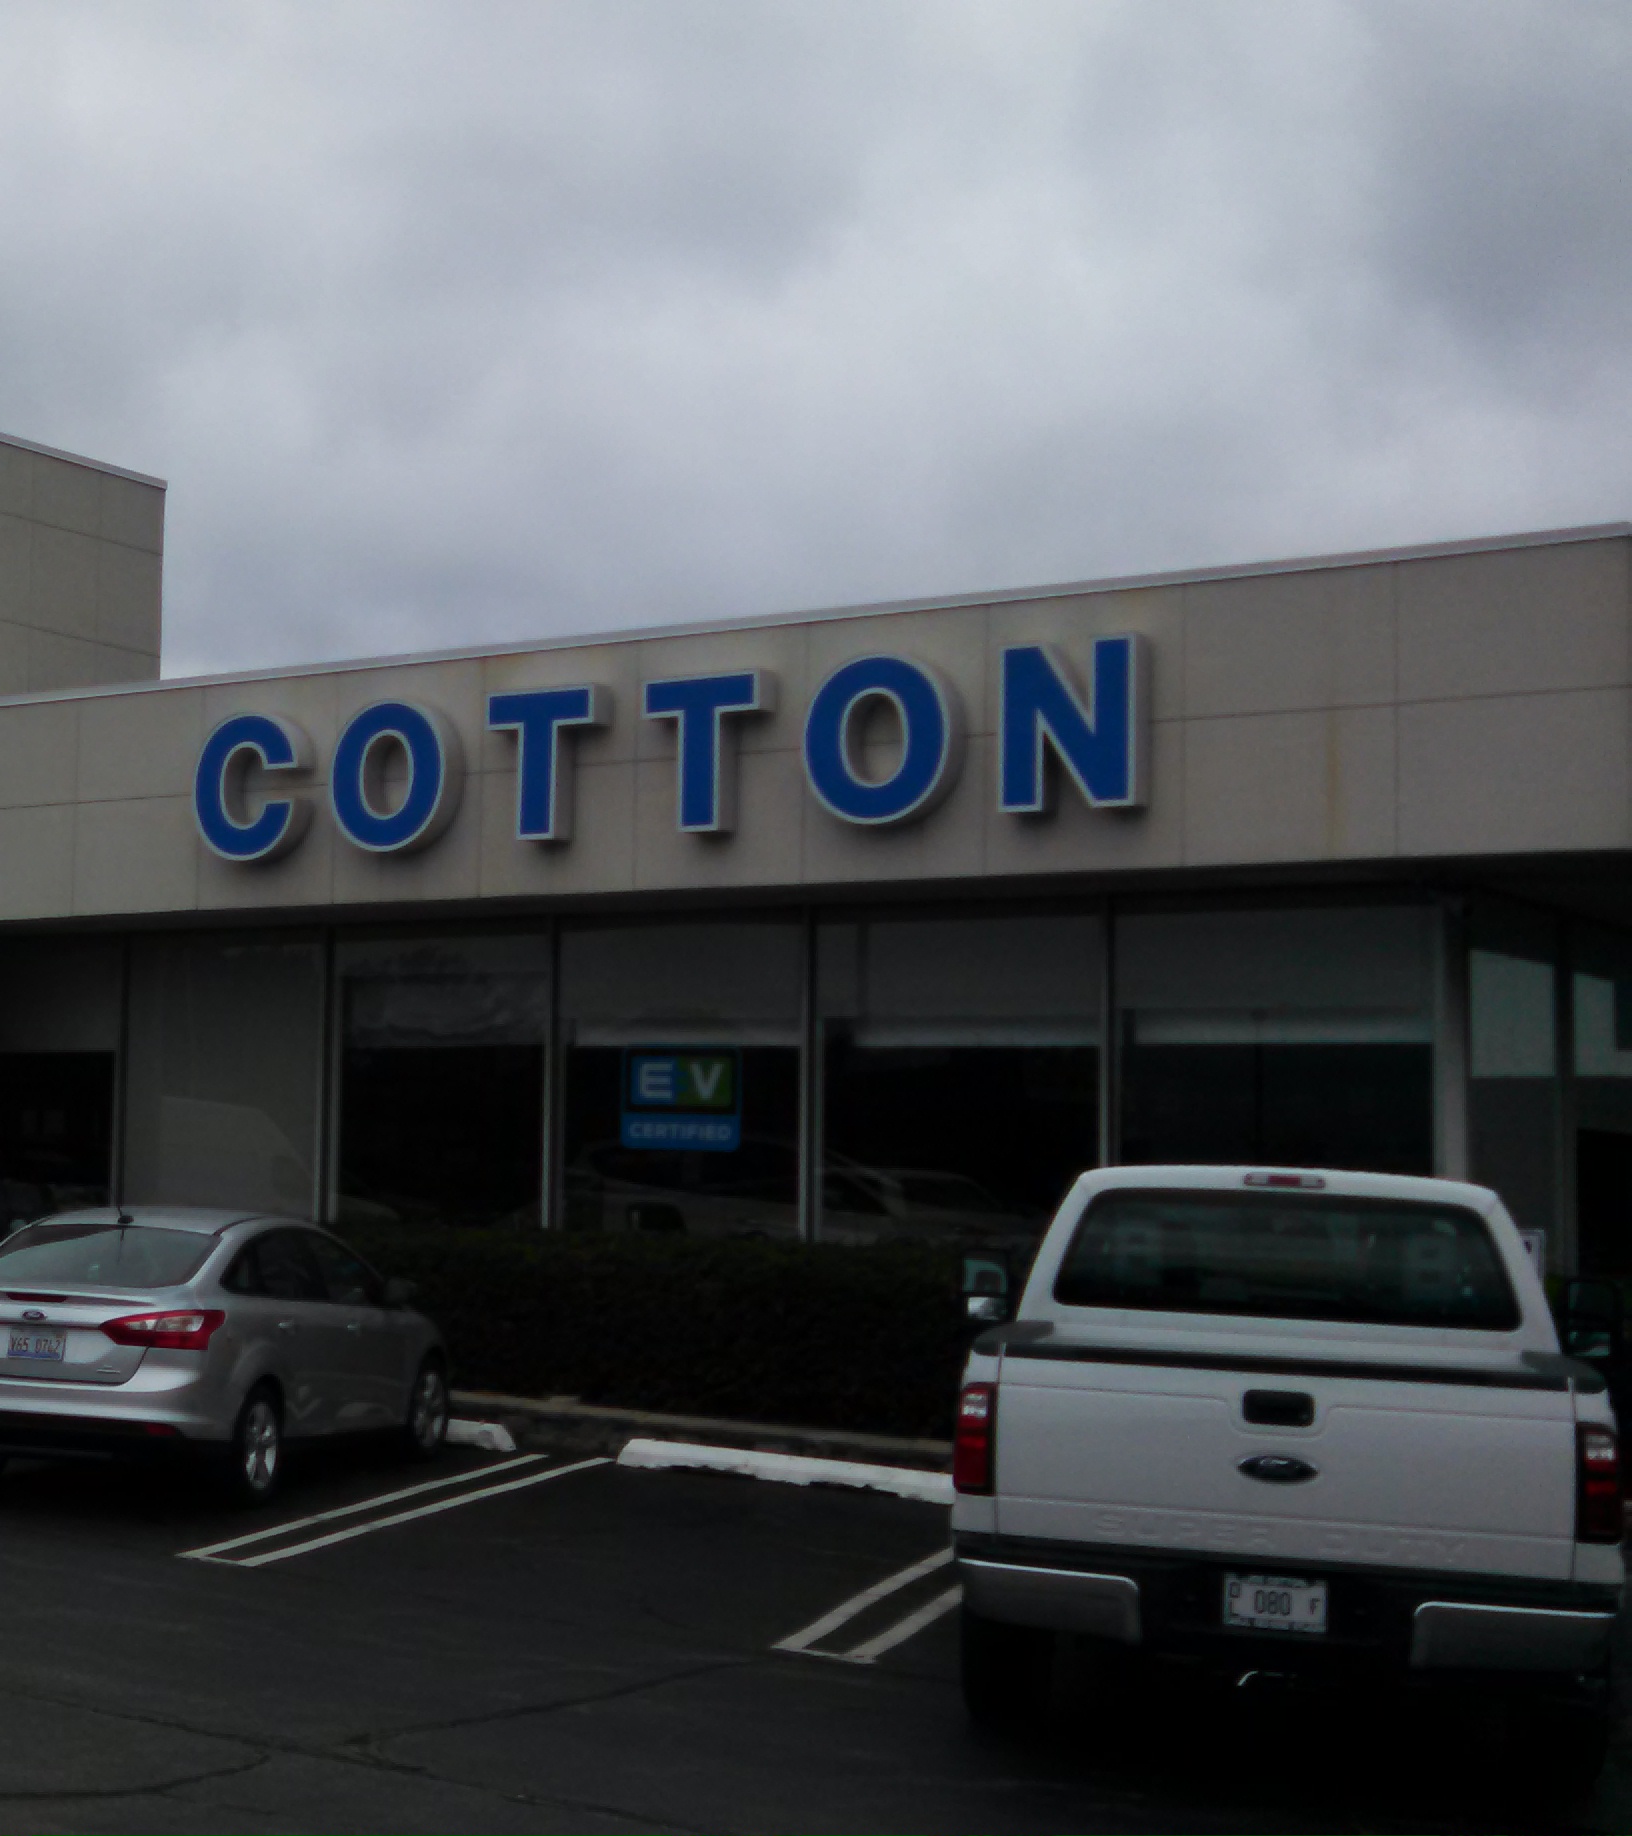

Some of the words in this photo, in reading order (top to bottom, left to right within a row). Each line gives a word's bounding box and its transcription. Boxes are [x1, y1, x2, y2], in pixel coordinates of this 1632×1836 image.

[195, 632, 1146, 862] COTTON
[636, 1060, 724, 1102] EV
[627, 1120, 732, 1141] CERTIFIED
[1092, 1512, 1275, 1550] SUPER
